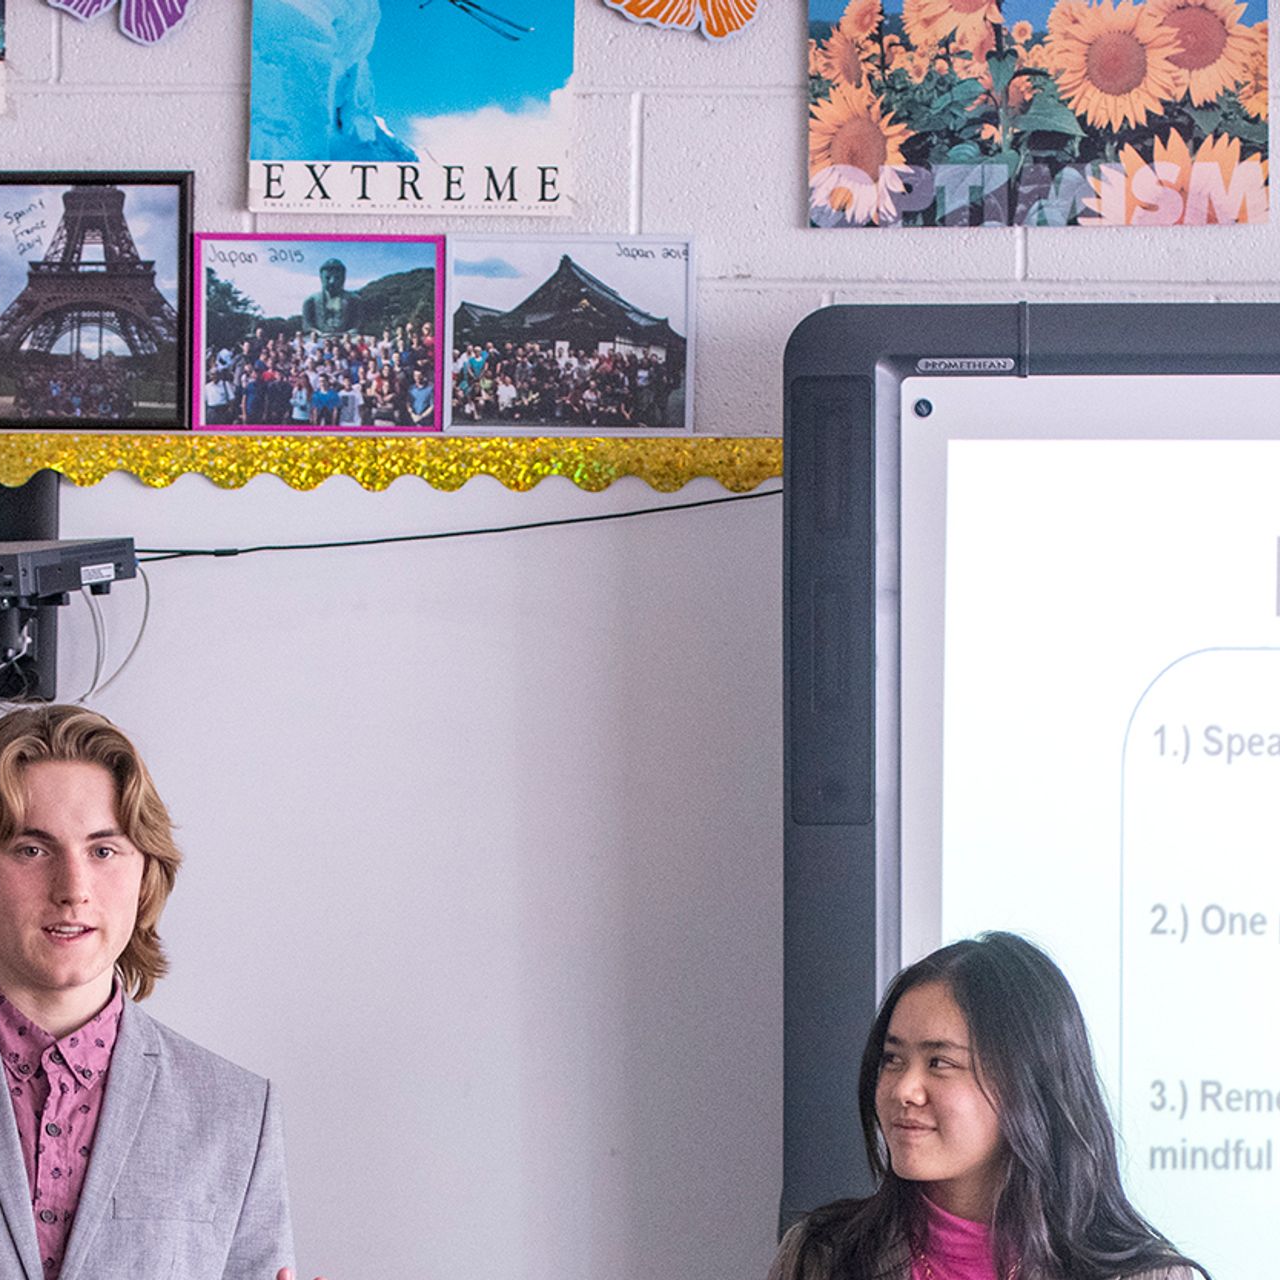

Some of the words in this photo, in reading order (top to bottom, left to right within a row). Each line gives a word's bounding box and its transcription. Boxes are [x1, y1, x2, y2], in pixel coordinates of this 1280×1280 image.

[263, 163, 560, 202] EXTREME
[807, 163, 1270, 227] OPTIMISM
[209, 243, 258, 268] Japan
[268, 248, 305, 263] 2015
[616, 241, 656, 260] Japan
[924, 361, 1007, 369] PROMETHEAN
[1153, 725, 1192, 766] 1.)
[1150, 903, 1190, 944] 2.)
[1202, 903, 1269, 937] One
[1150, 1079, 1190, 1119] 3.)
[1148, 1137, 1274, 1173] mindful
